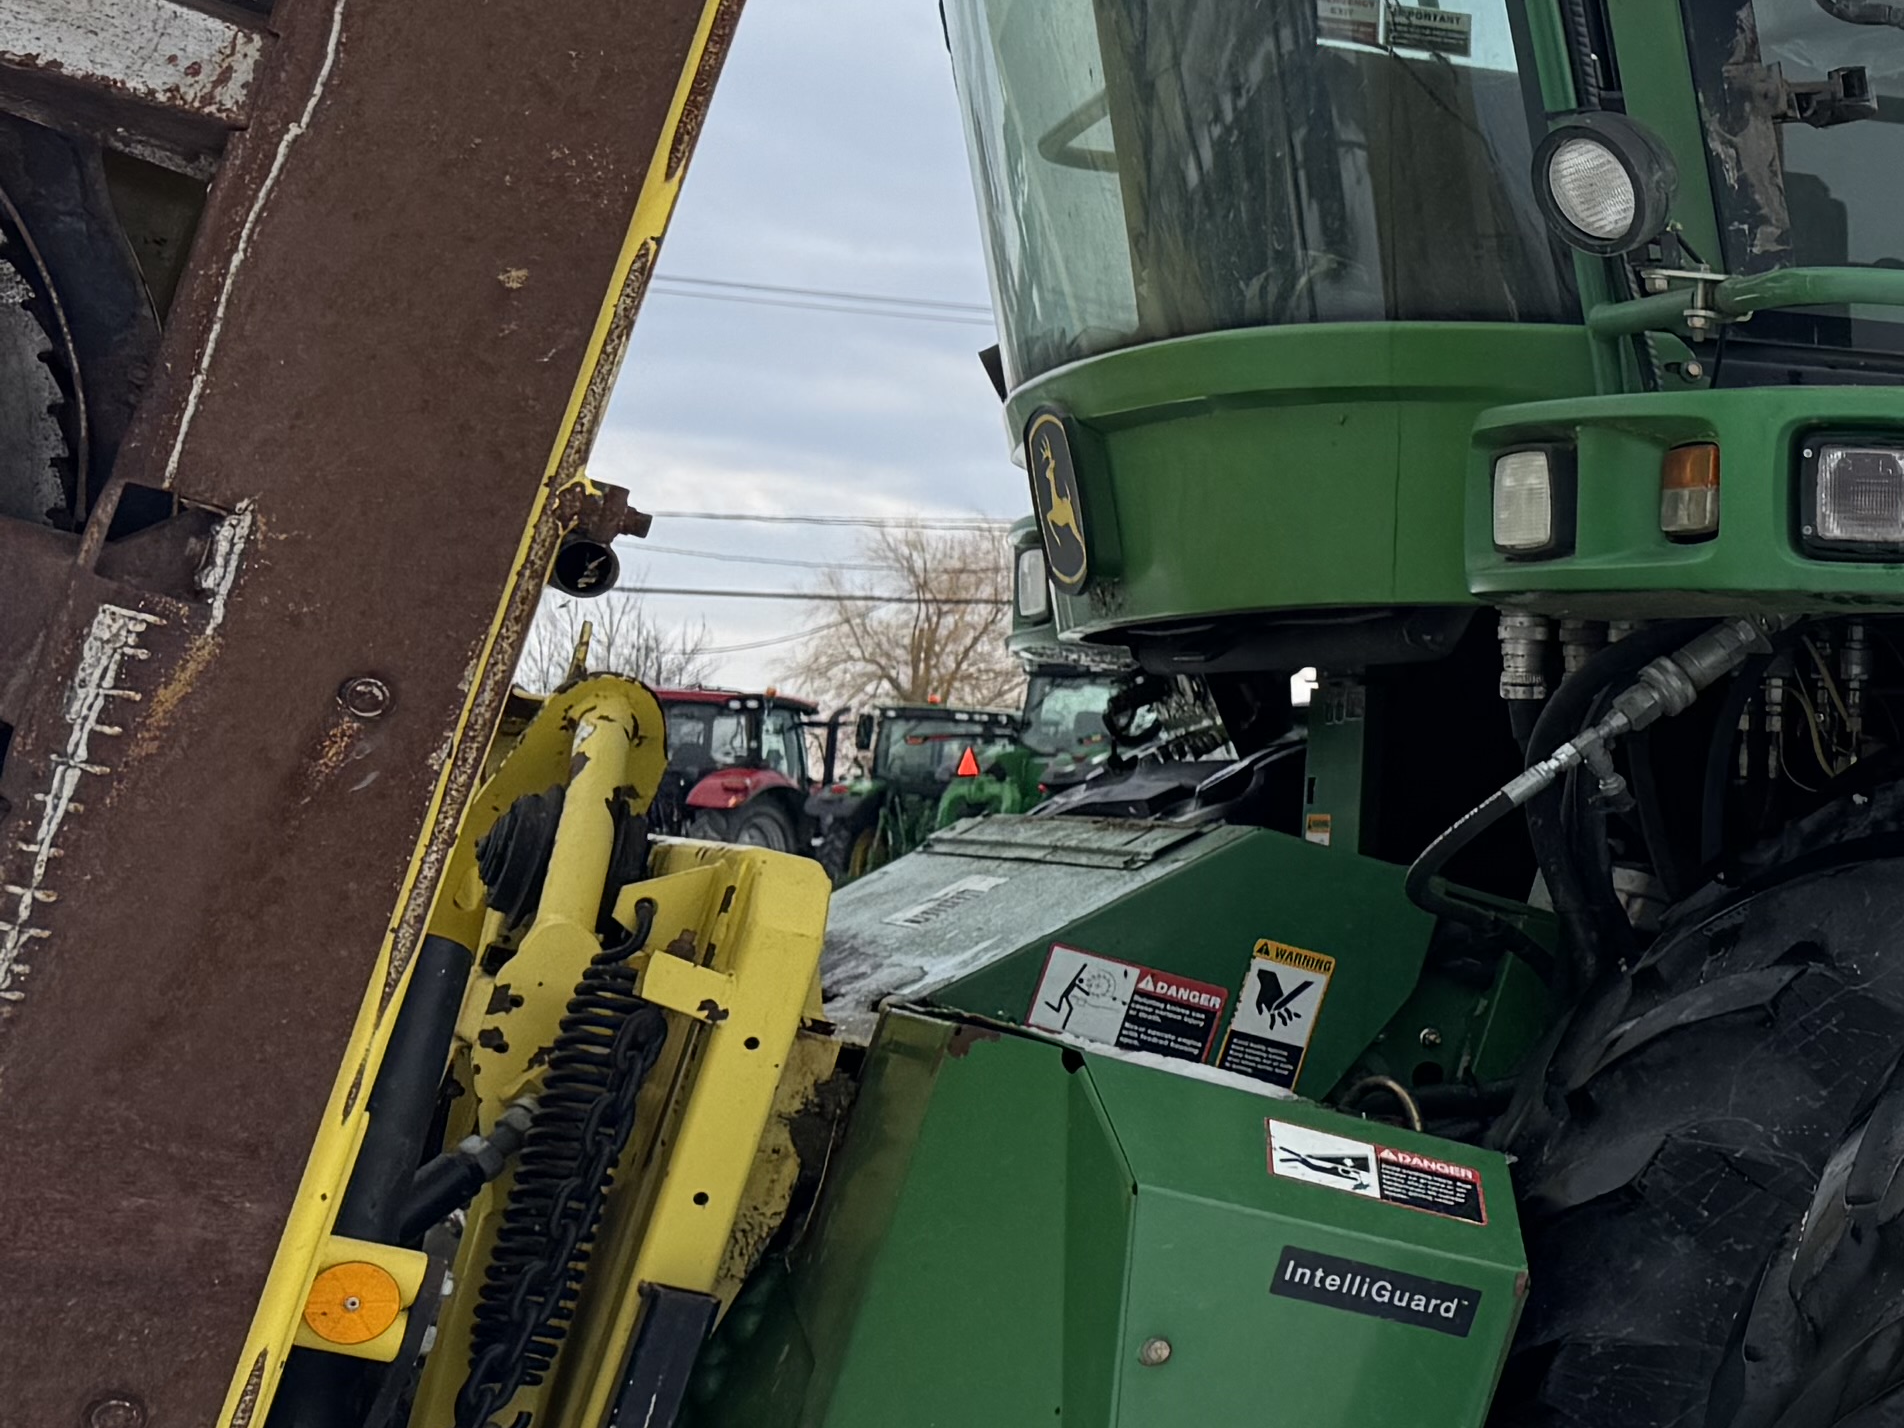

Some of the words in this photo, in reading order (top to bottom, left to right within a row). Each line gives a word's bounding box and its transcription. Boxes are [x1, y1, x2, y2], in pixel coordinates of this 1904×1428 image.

[1275, 948, 1332, 973] WARNING
[1155, 980, 1222, 1010] DANGER
[1398, 1152, 1473, 1179] DANGER
